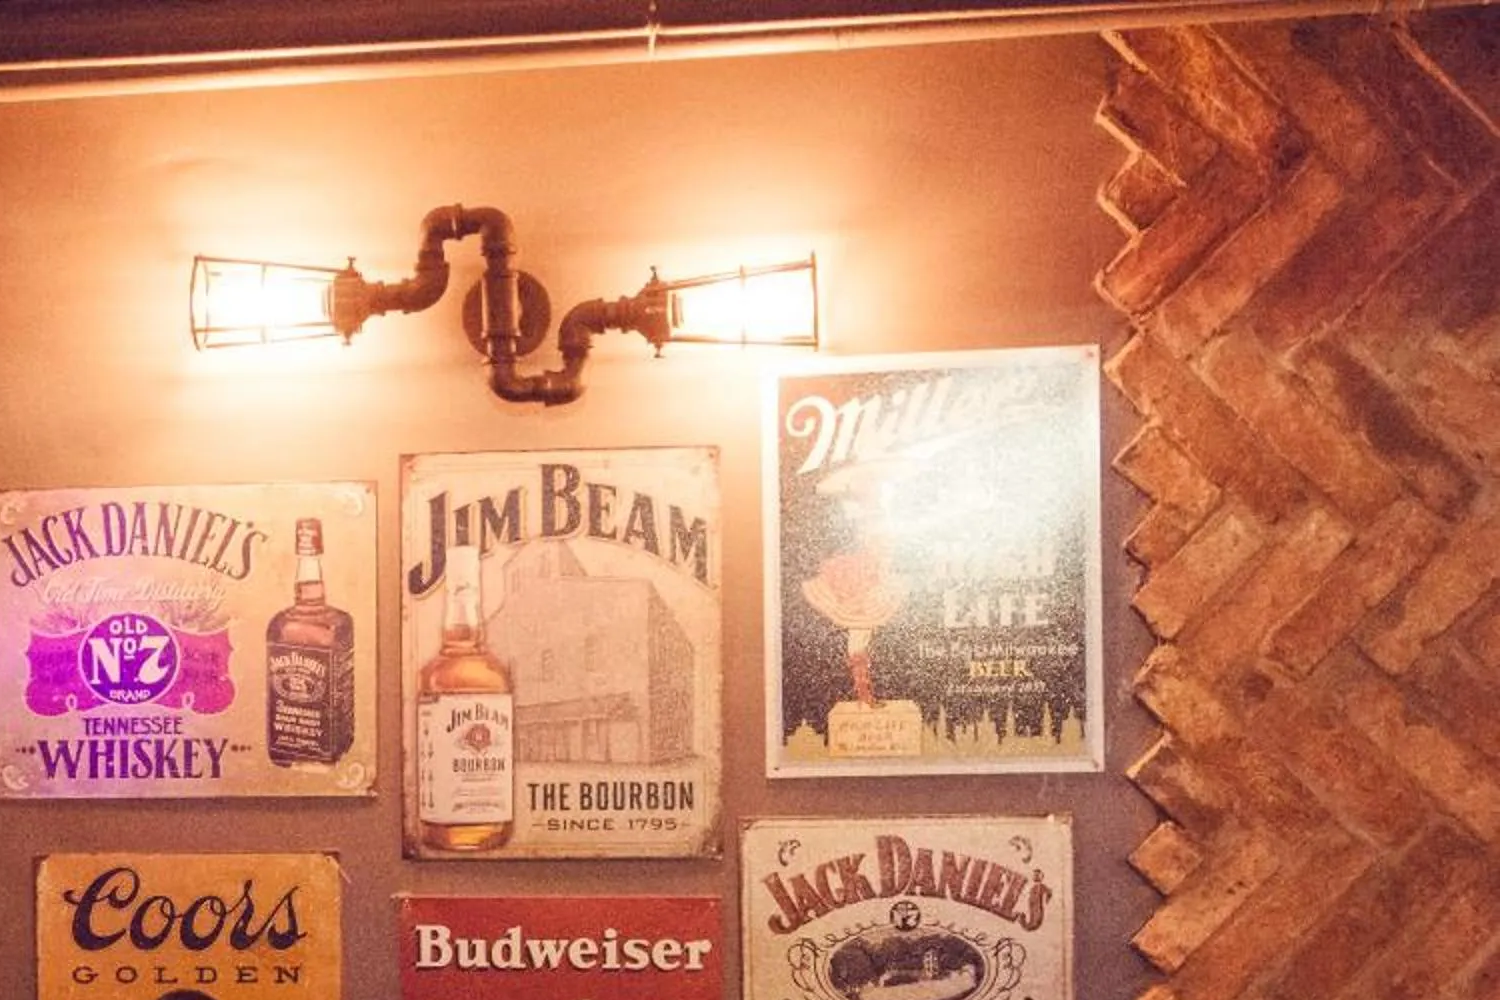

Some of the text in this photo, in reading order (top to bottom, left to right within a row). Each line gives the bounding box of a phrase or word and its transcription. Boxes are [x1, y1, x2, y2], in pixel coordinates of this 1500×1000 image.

[1, 501, 269, 588] JACK DANIEL'S
[408, 462, 709, 595] JIM BEAM
[109, 615, 148, 635] OLD
[82, 717, 184, 735] TENNESSEE
[37, 738, 229, 779] WHISKEY
[452, 758, 505, 772] BOURBON
[527, 782, 571, 811] THE
[580, 781, 695, 811] BOURBON
[547, 817, 678, 832] SINCE 1795
[762, 834, 1053, 935] JACK DANIEL'S
[64, 867, 308, 950] Coors
[414, 925, 713, 970] Budweiser
[72, 965, 300, 984] GOLDEN
